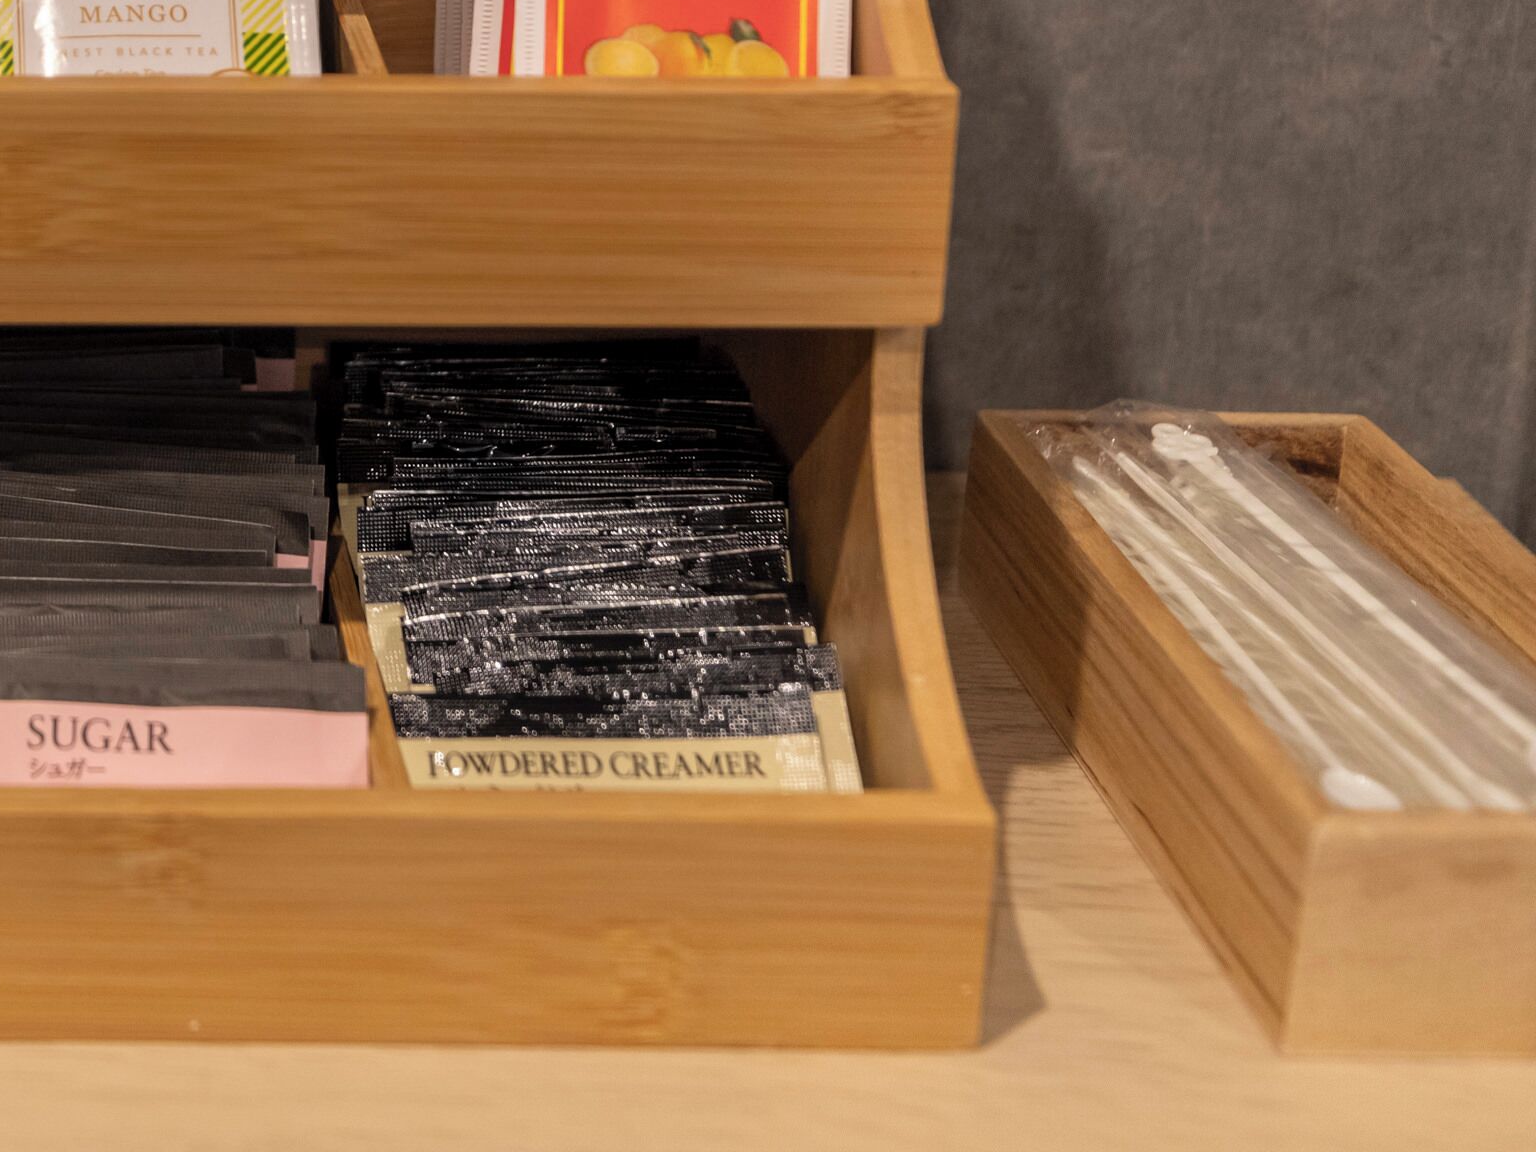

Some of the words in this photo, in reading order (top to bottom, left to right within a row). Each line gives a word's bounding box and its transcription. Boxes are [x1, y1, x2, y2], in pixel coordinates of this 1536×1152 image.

[79, 4, 188, 24] MANGO
[115, 47, 174, 57] BLACK
[185, 47, 218, 57] TEA
[26, 714, 174, 755] SUGAR
[30, 757, 107, 780] シュガー
[608, 750, 767, 780] CREAMER
